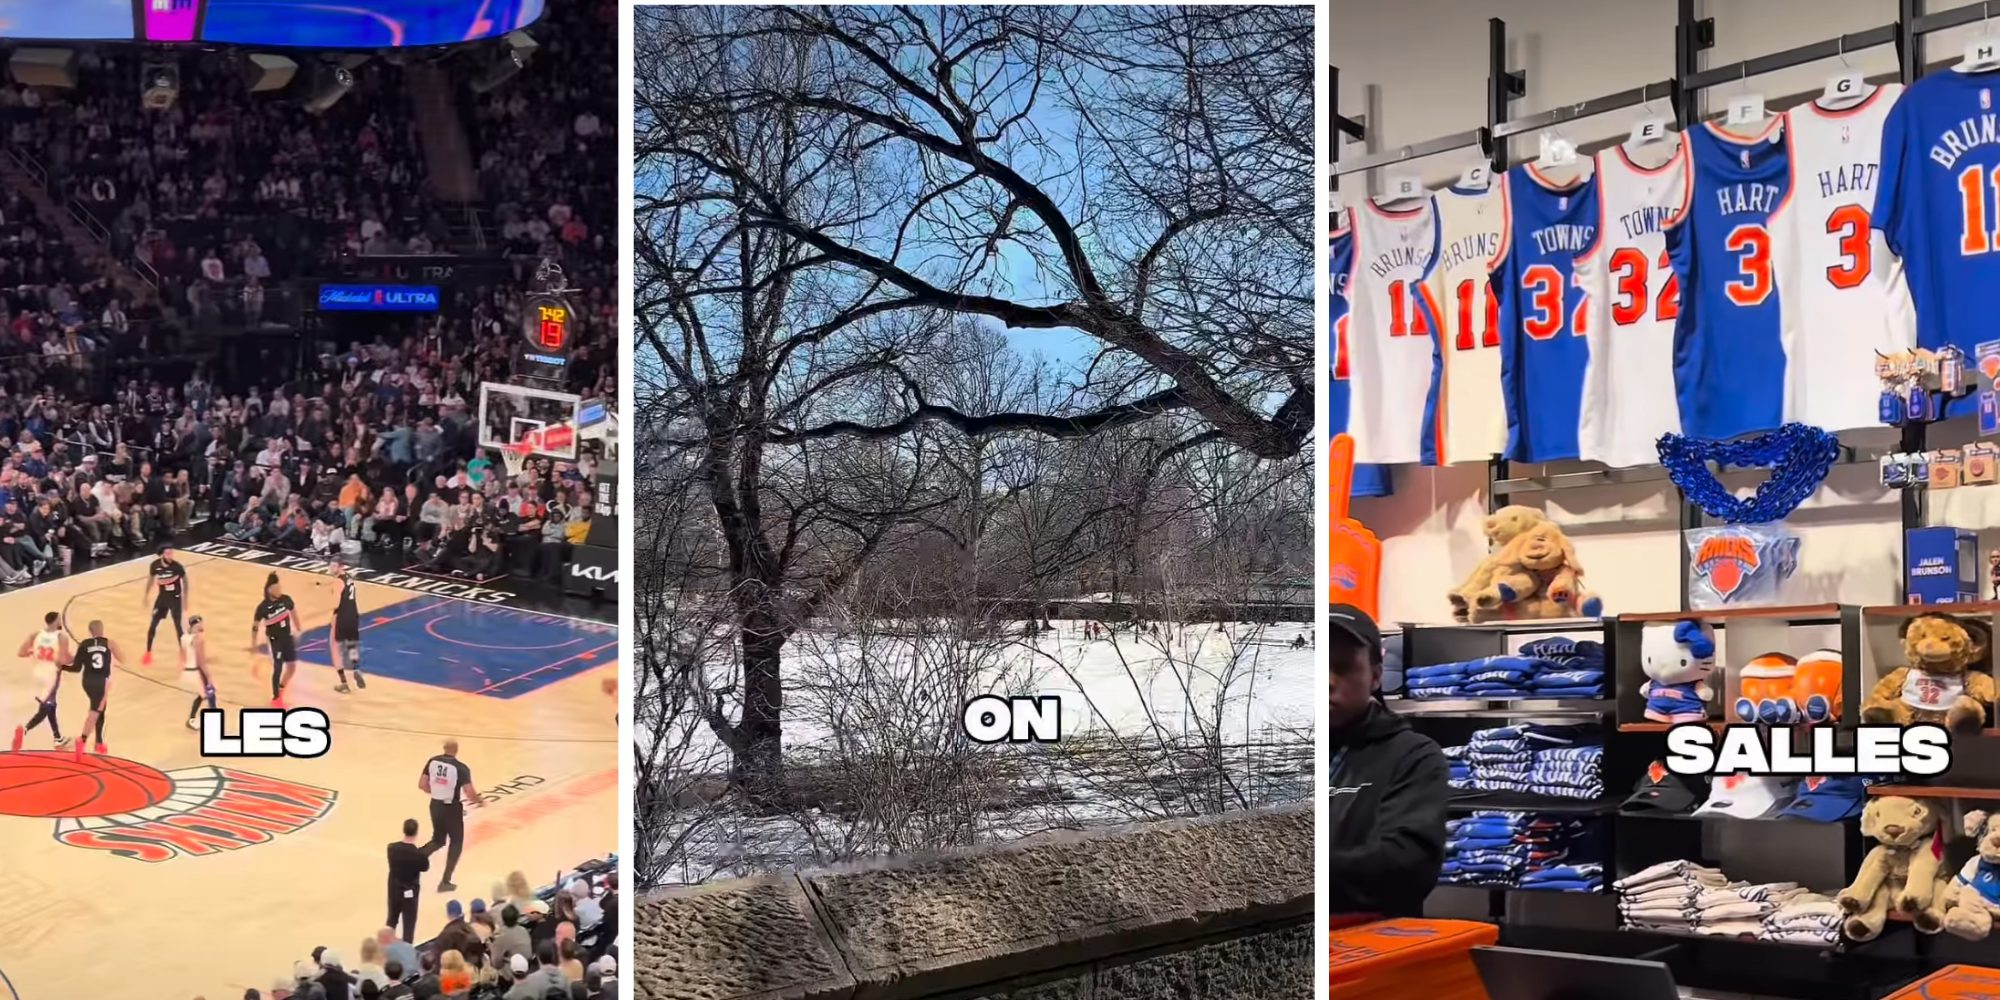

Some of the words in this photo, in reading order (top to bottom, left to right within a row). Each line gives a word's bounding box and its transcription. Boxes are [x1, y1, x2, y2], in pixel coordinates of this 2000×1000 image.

[1978, 46, 1992, 59] H
[1837, 80, 1850, 92] G
[1741, 106, 1752, 118] F
[1642, 124, 1653, 136] E
[1930, 114, 2000, 170] BRUN
[1401, 182, 1411, 192] B
[1471, 169, 1480, 180] C
[1818, 163, 1878, 198] HART
[1716, 183, 1780, 216] HART
[1443, 233, 1499, 272] BRUNS
[1826, 203, 1872, 290] 3
[1725, 223, 1773, 307] 3
[385, 292, 436, 304] ULTRA
[1456, 279, 1500, 351] 11
[1696, 535, 1760, 568] KNICKS
[182, 541, 276, 560] NEW
[369, 572, 517, 602] KNICKS
[1911, 566, 1952, 576] BRUNSON
[92, 653, 104, 669] 3
[1919, 686, 1940, 705] 32
[53, 766, 338, 863] KNICKS
